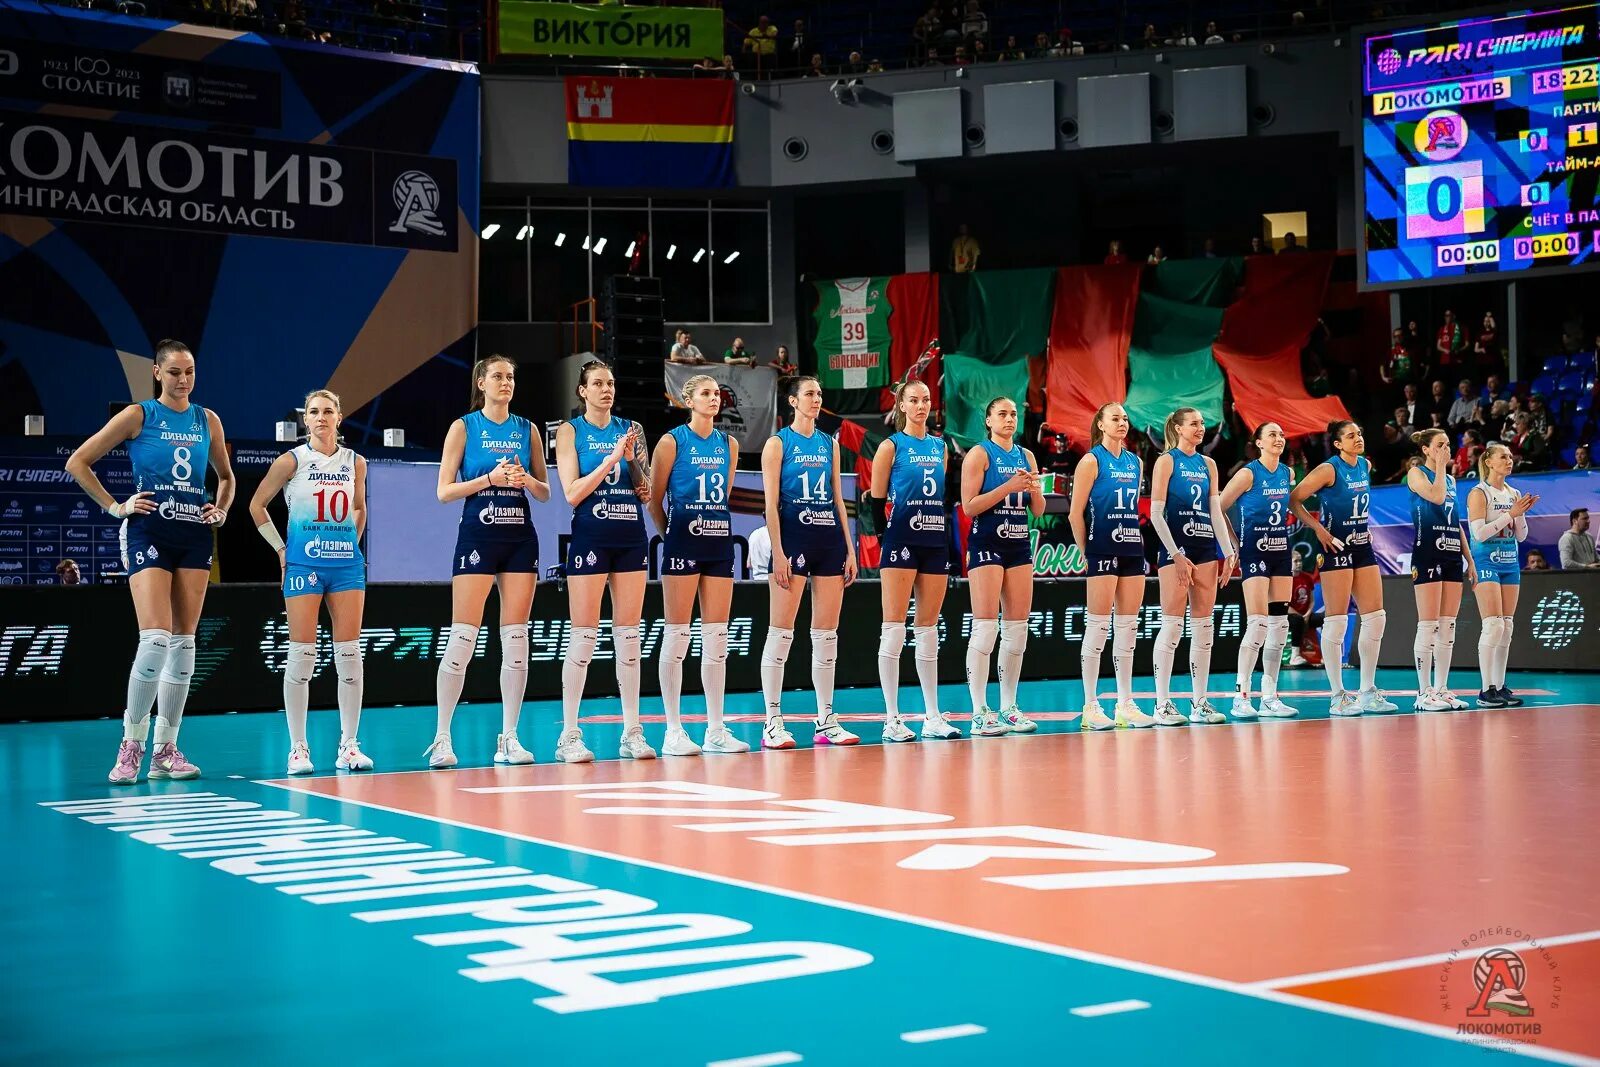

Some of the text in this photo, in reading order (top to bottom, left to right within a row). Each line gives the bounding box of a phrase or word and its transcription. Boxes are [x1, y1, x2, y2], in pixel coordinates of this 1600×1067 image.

[1406, 25, 1584, 68] PARI СУПЕРЛИГА
[115, 69, 140, 81] 2023
[42, 73, 140, 99] СТОЛЕТИЕ
[1379, 82, 1504, 112] ЛОКОМОТИВ
[1527, 125, 1589, 150] 0 1
[0, 123, 344, 207] ОМОТИВ
[1427, 176, 1462, 222] 0
[1528, 185, 1542, 203] 0
[180, 203, 296, 230] ОБЛАСТЬ
[1523, 212, 1559, 228] СЧЁТ
[1565, 212, 1573, 224] В
[1441, 237, 1576, 263] 00:00 00:00
[843, 322, 865, 342] 39
[829, 352, 880, 370] БОЛЕЛЬЩИК
[160, 432, 203, 443] ДИНАМО
[481, 441, 522, 449] ДИНАМО
[171, 446, 192, 481] 8
[691, 456, 724, 465] ДИНАМО
[794, 455, 828, 463] ДИНАМО
[910, 456, 942, 464] ДИНАМО
[308, 473, 350, 481] ДИНАМО
[602, 455, 621, 485] 9
[695, 472, 725, 504] 13
[798, 471, 828, 501] 14
[922, 468, 937, 497] 5
[1114, 488, 1137, 510] 17
[1190, 484, 1202, 511] 2
[1263, 488, 1288, 496] ДИНАМО
[312, 489, 349, 524] 10
[494, 507, 524, 517] ГАЗПРОМ
[1350, 493, 1370, 519] 12
[922, 514, 945, 524] ГАЗПРОМ
[1268, 501, 1282, 526] 3
[1444, 502, 1454, 525] 7
[702, 519, 729, 529] ГАЗПРОМ
[321, 540, 353, 551] ГАЗПРОМ
[136, 551, 145, 565] 8
[459, 555, 466, 569] 1
[574, 555, 583, 569] 9
[890, 550, 898, 562] 5
[978, 551, 992, 562] 11
[1333, 556, 1348, 567] 12
[669, 557, 685, 571] 13
[1097, 560, 1111, 572] 17
[1249, 563, 1257, 573] 3
[1427, 569, 1434, 578] 7
[1480, 569, 1493, 579] 19
[290, 576, 304, 590] 10
